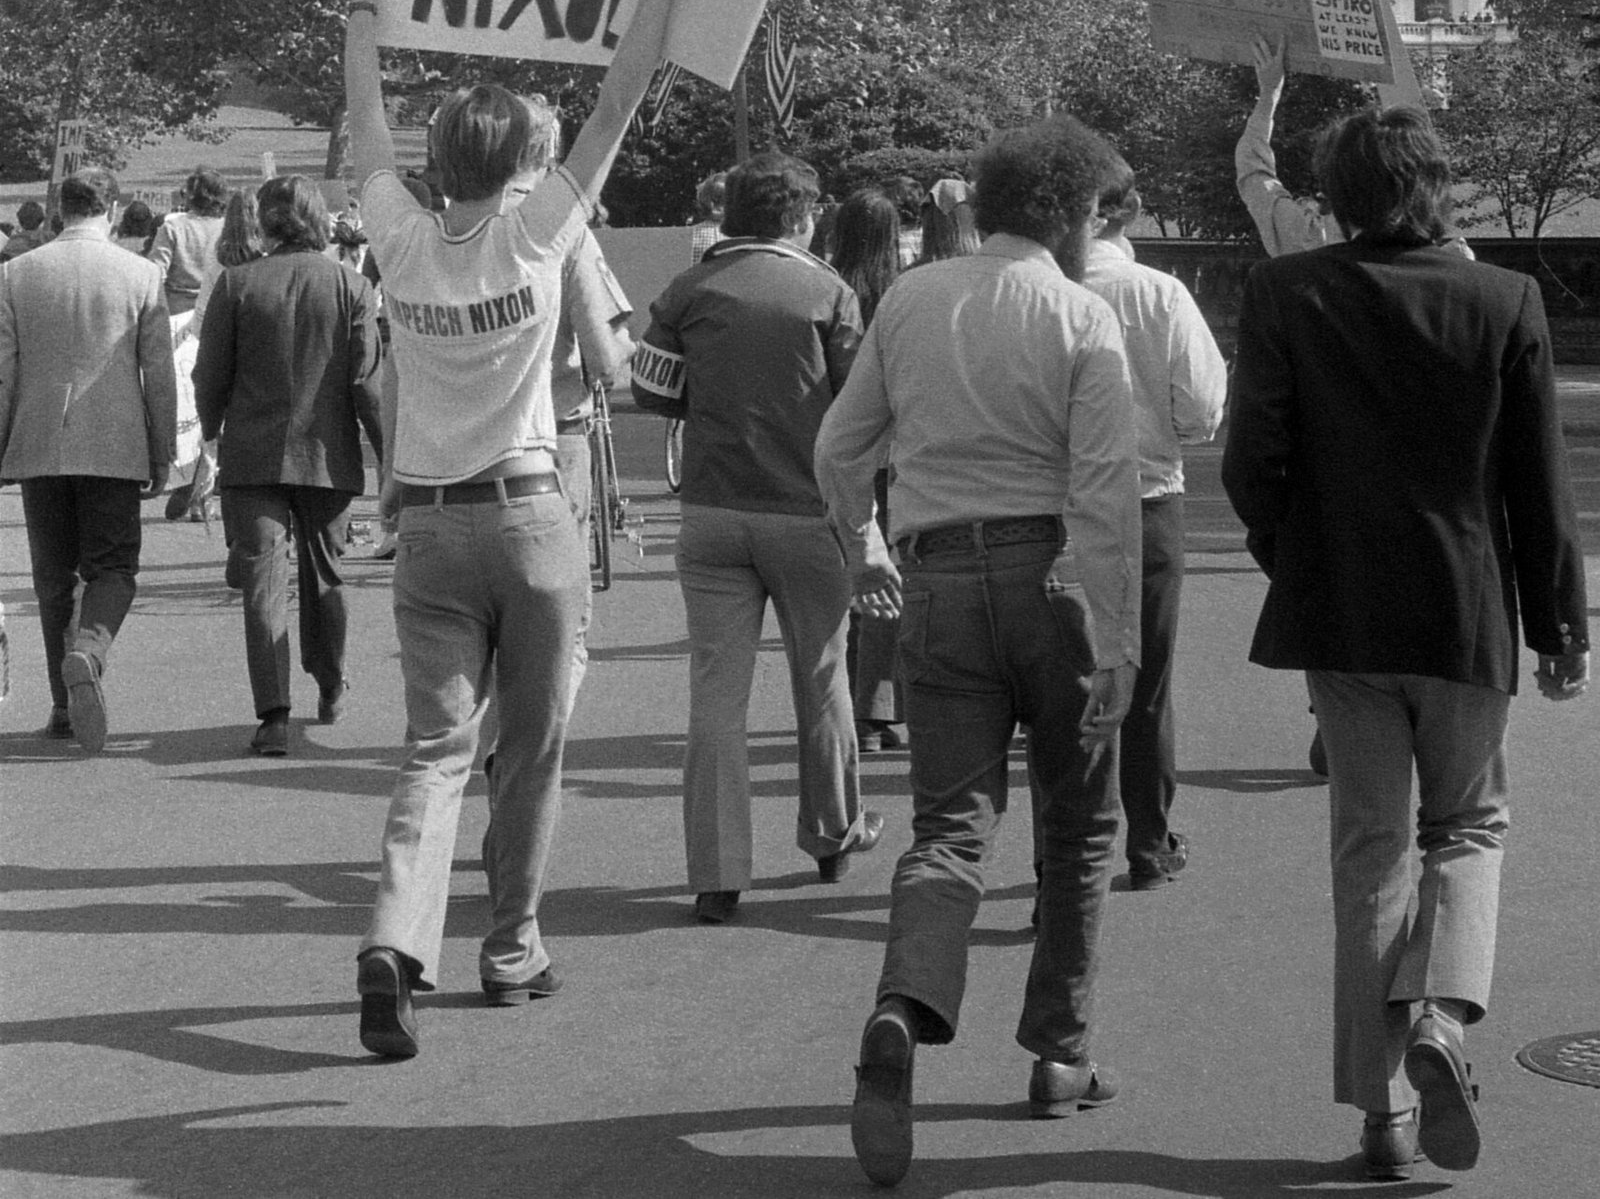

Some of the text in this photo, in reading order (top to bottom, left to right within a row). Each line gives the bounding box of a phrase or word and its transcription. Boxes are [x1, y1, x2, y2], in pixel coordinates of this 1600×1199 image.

[1319, 12, 1369, 25] AT LEAST
[1319, 25, 1337, 35] WE
[1321, 38, 1382, 56] HIS PRICE
[388, 286, 535, 337] PEACH NIXON
